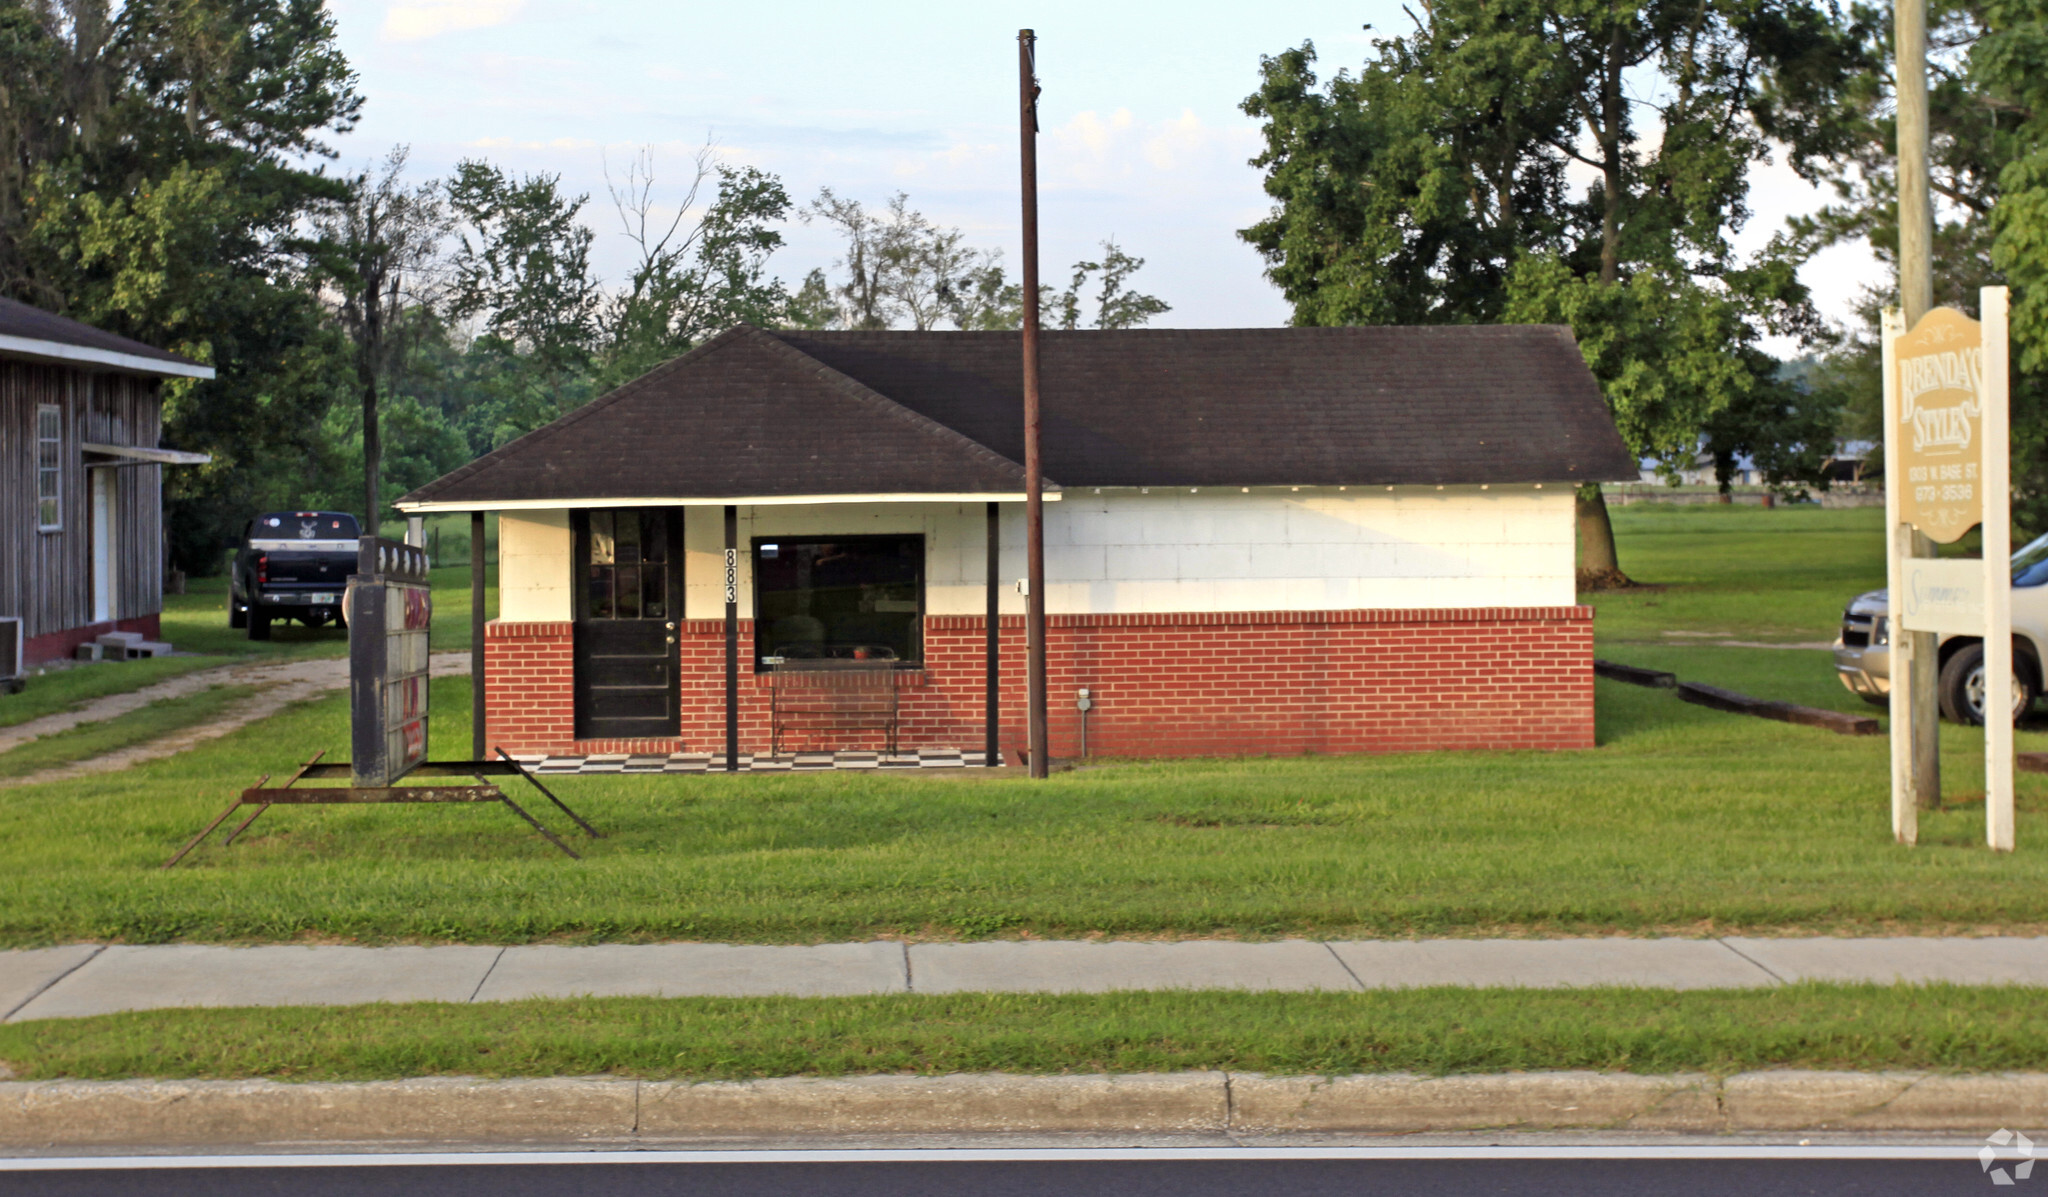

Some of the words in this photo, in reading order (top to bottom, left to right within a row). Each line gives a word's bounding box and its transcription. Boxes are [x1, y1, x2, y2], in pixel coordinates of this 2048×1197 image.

[1899, 346, 1982, 424] BRENDA'S
[1913, 404, 1972, 452] STYLES
[1940, 463, 1963, 480] BASE
[726, 549, 735, 602] 883
